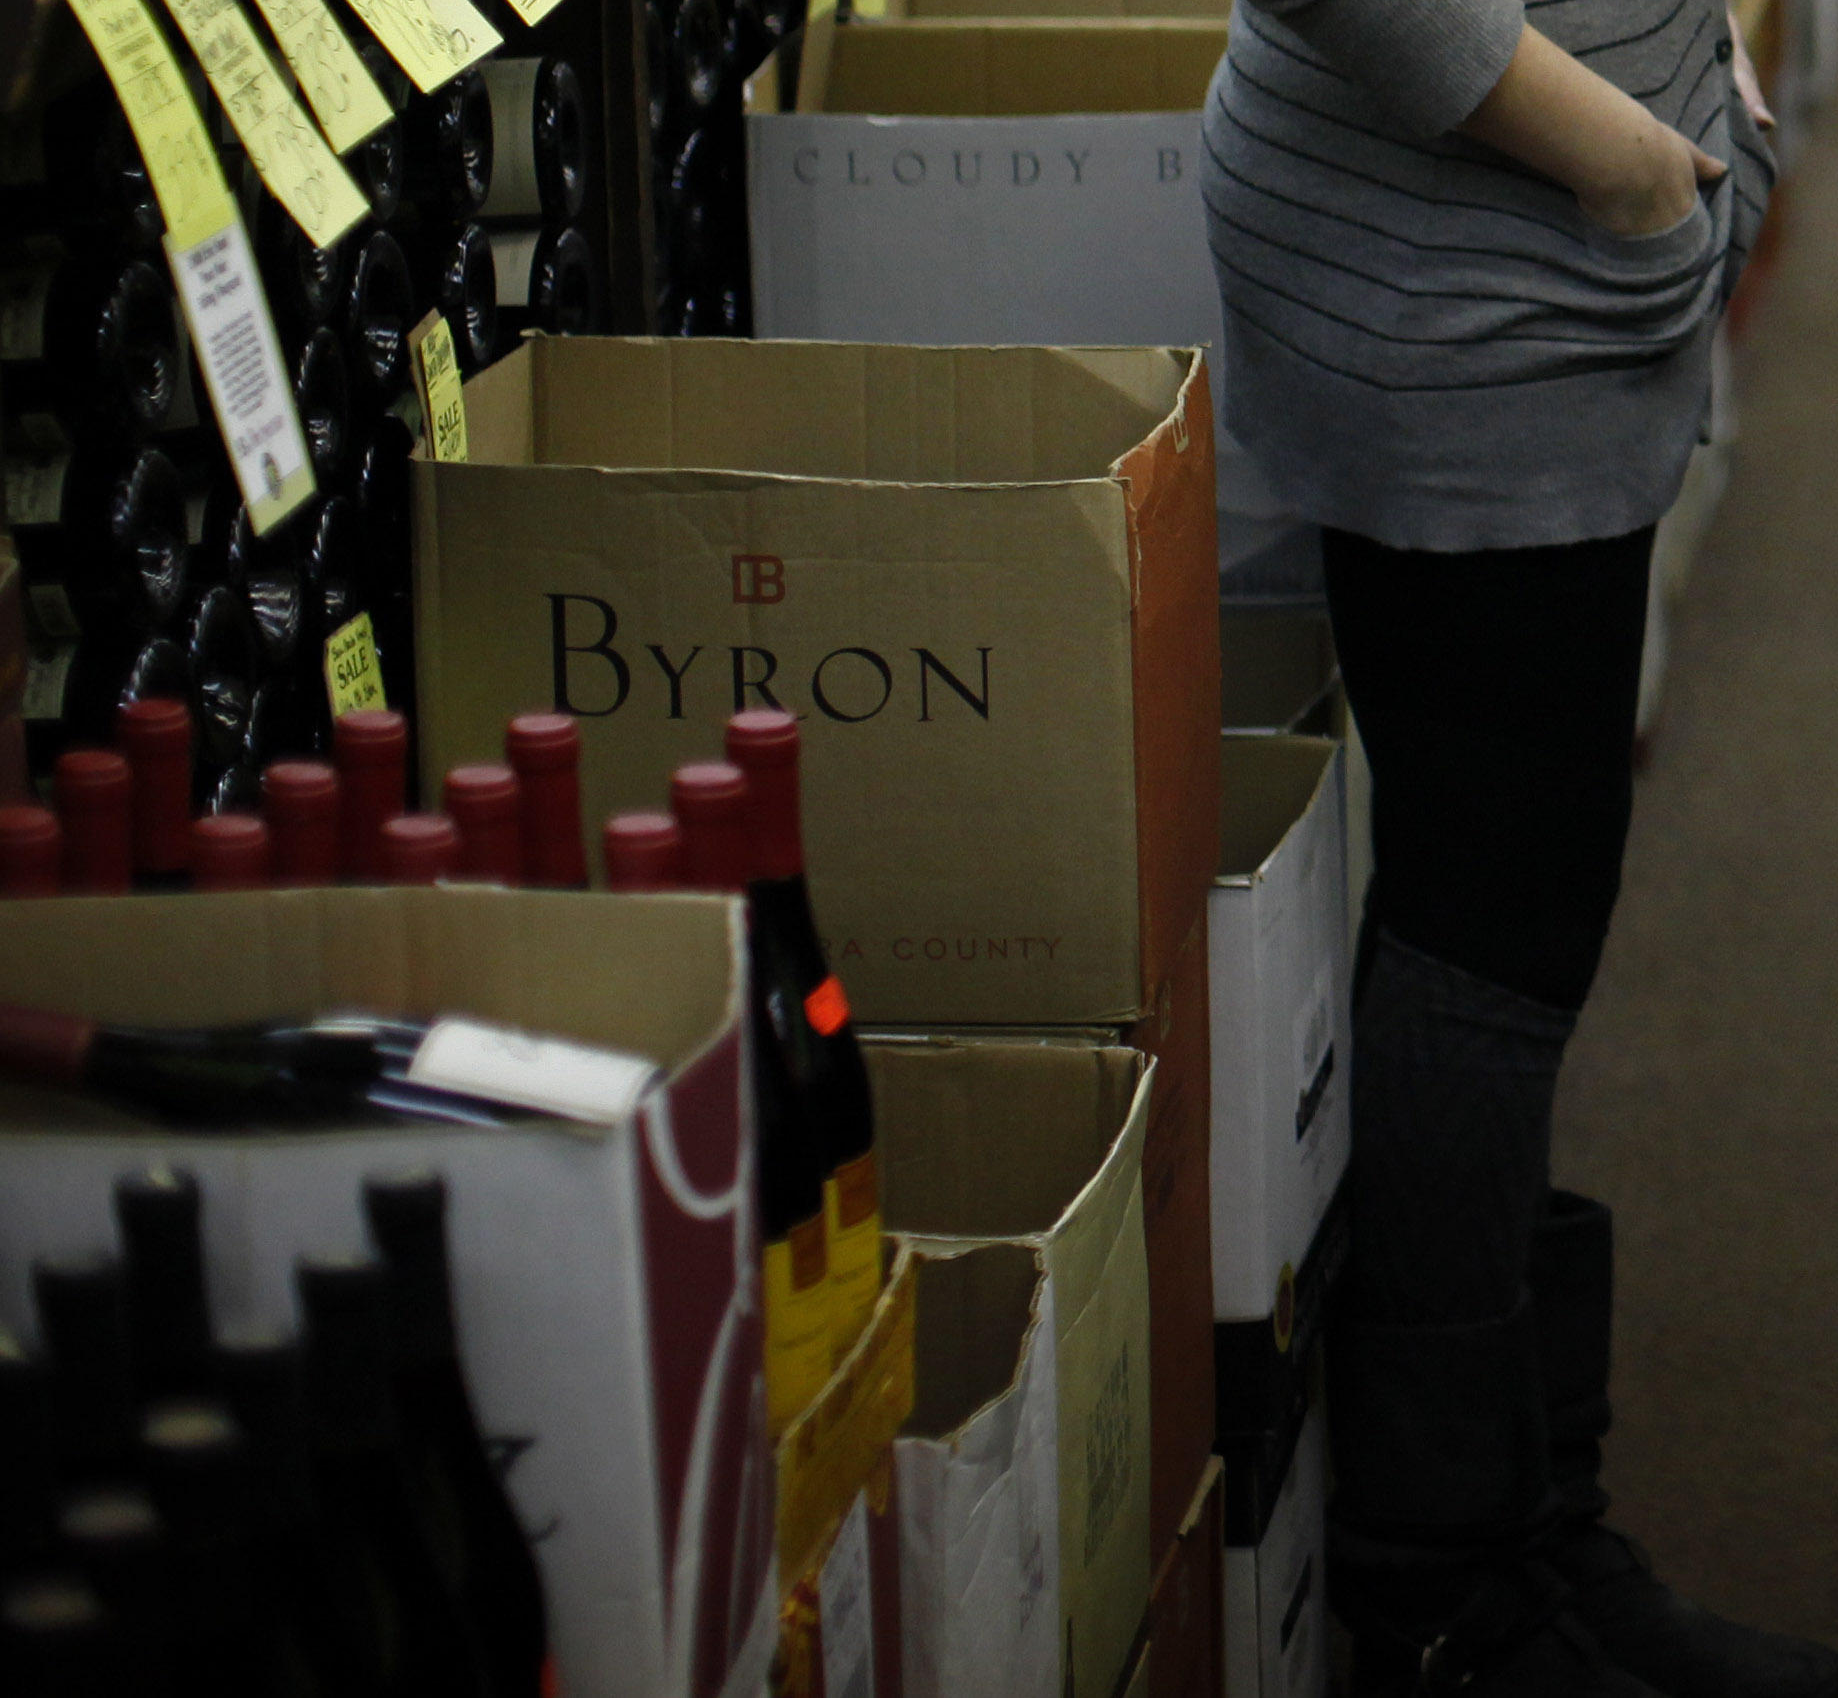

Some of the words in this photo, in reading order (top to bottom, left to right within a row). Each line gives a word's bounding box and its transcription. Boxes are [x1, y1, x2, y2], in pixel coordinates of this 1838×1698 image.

[793, 149, 1090, 186] CLOUDY
[336, 647, 370, 690] SALE
[543, 593, 994, 723] BYRON
[892, 937, 1061, 961] COUNTY
